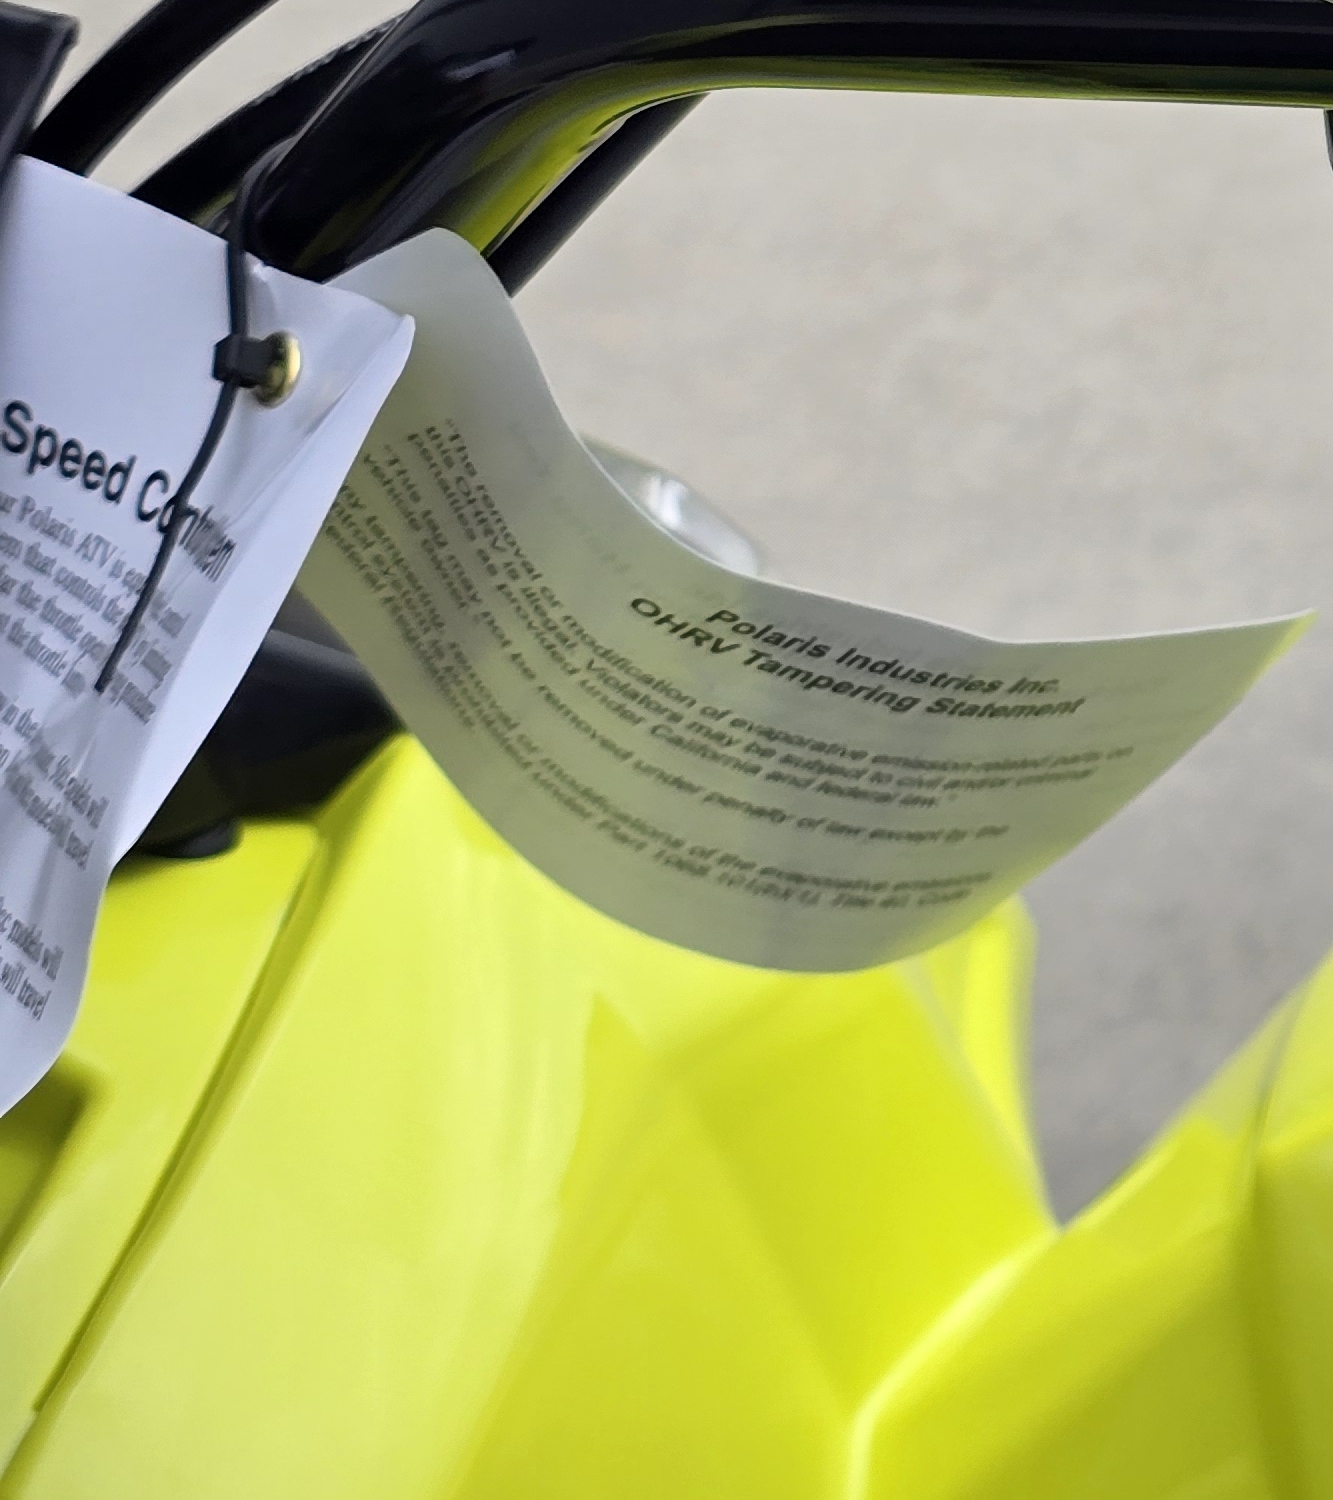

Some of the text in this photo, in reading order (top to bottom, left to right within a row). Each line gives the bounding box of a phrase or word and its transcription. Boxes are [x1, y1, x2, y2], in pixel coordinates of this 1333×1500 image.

[1, 400, 138, 505] Speed
[561, 614, 698, 709] modification
[629, 597, 1087, 720] OHRV Tampering Statement
[705, 608, 832, 658] Polaris
[835, 647, 1005, 694] Industries
